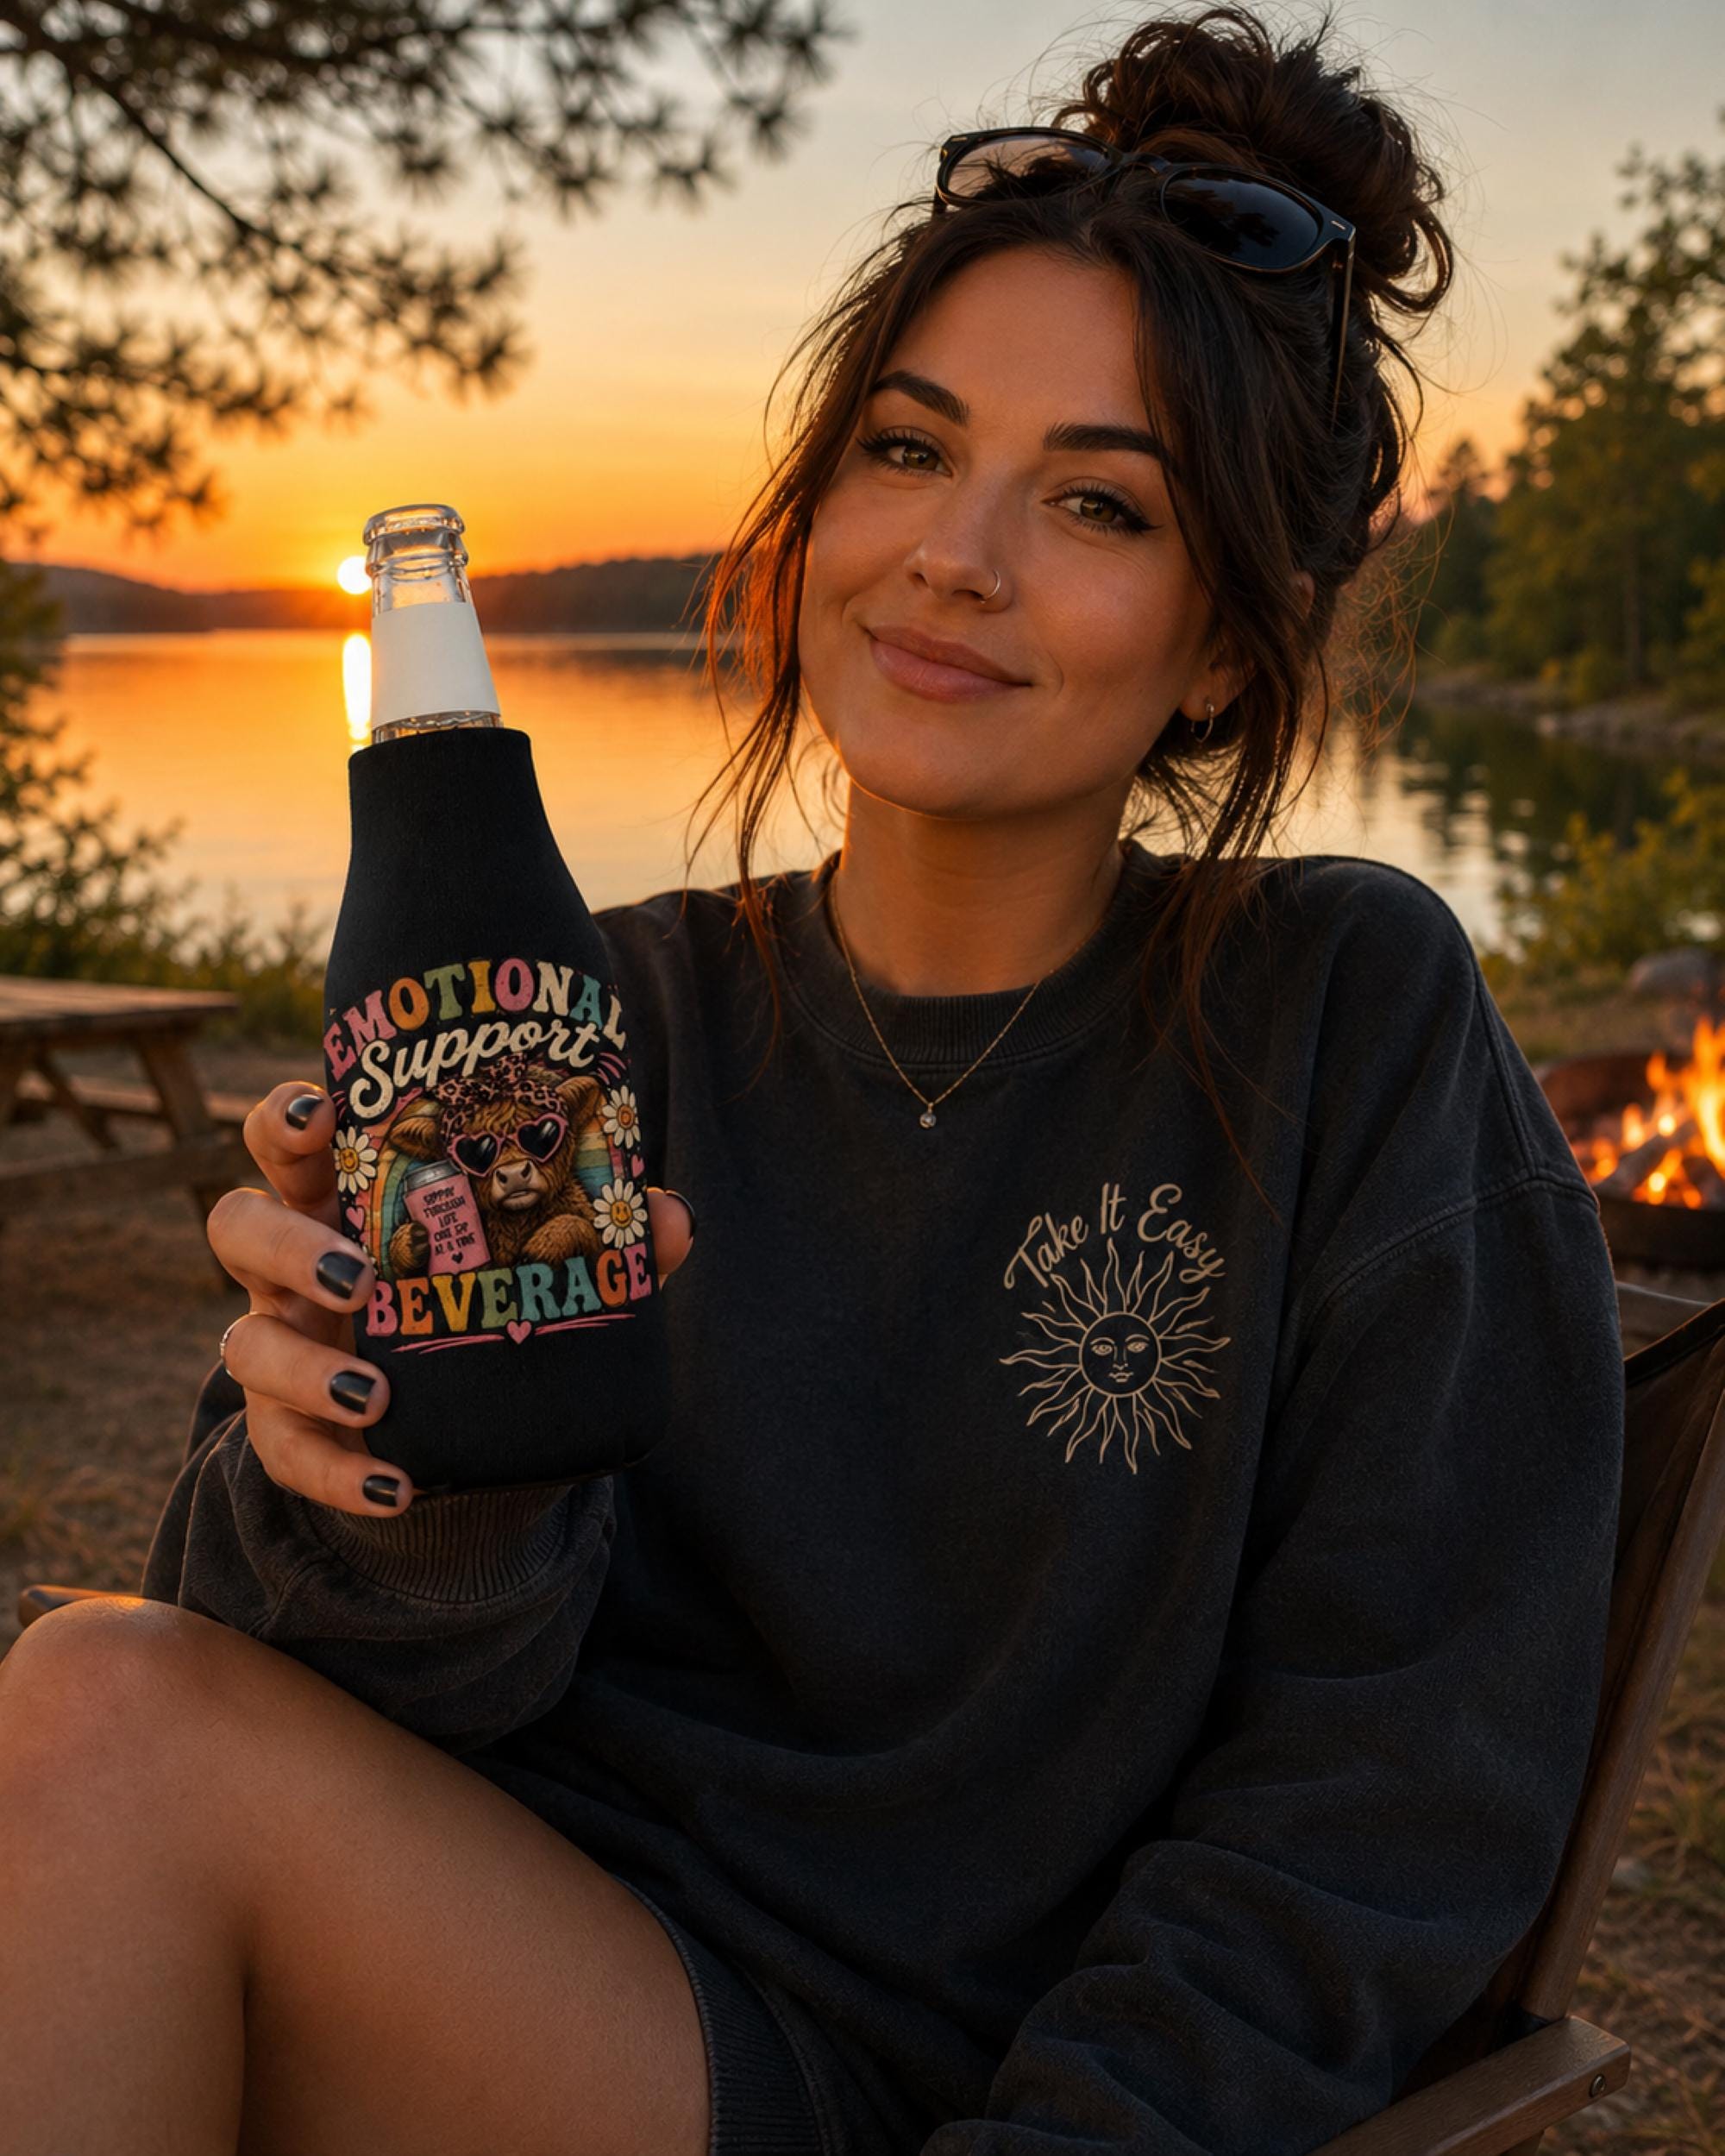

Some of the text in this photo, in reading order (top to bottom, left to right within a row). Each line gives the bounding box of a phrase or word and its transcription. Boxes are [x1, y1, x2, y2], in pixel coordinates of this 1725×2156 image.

[323, 958, 627, 1081] EMOTIONAL
[349, 1020, 600, 1119] Support
[1003, 1182, 1226, 1290] Take It Easy
[366, 1243, 653, 1337] BEVERAGE
